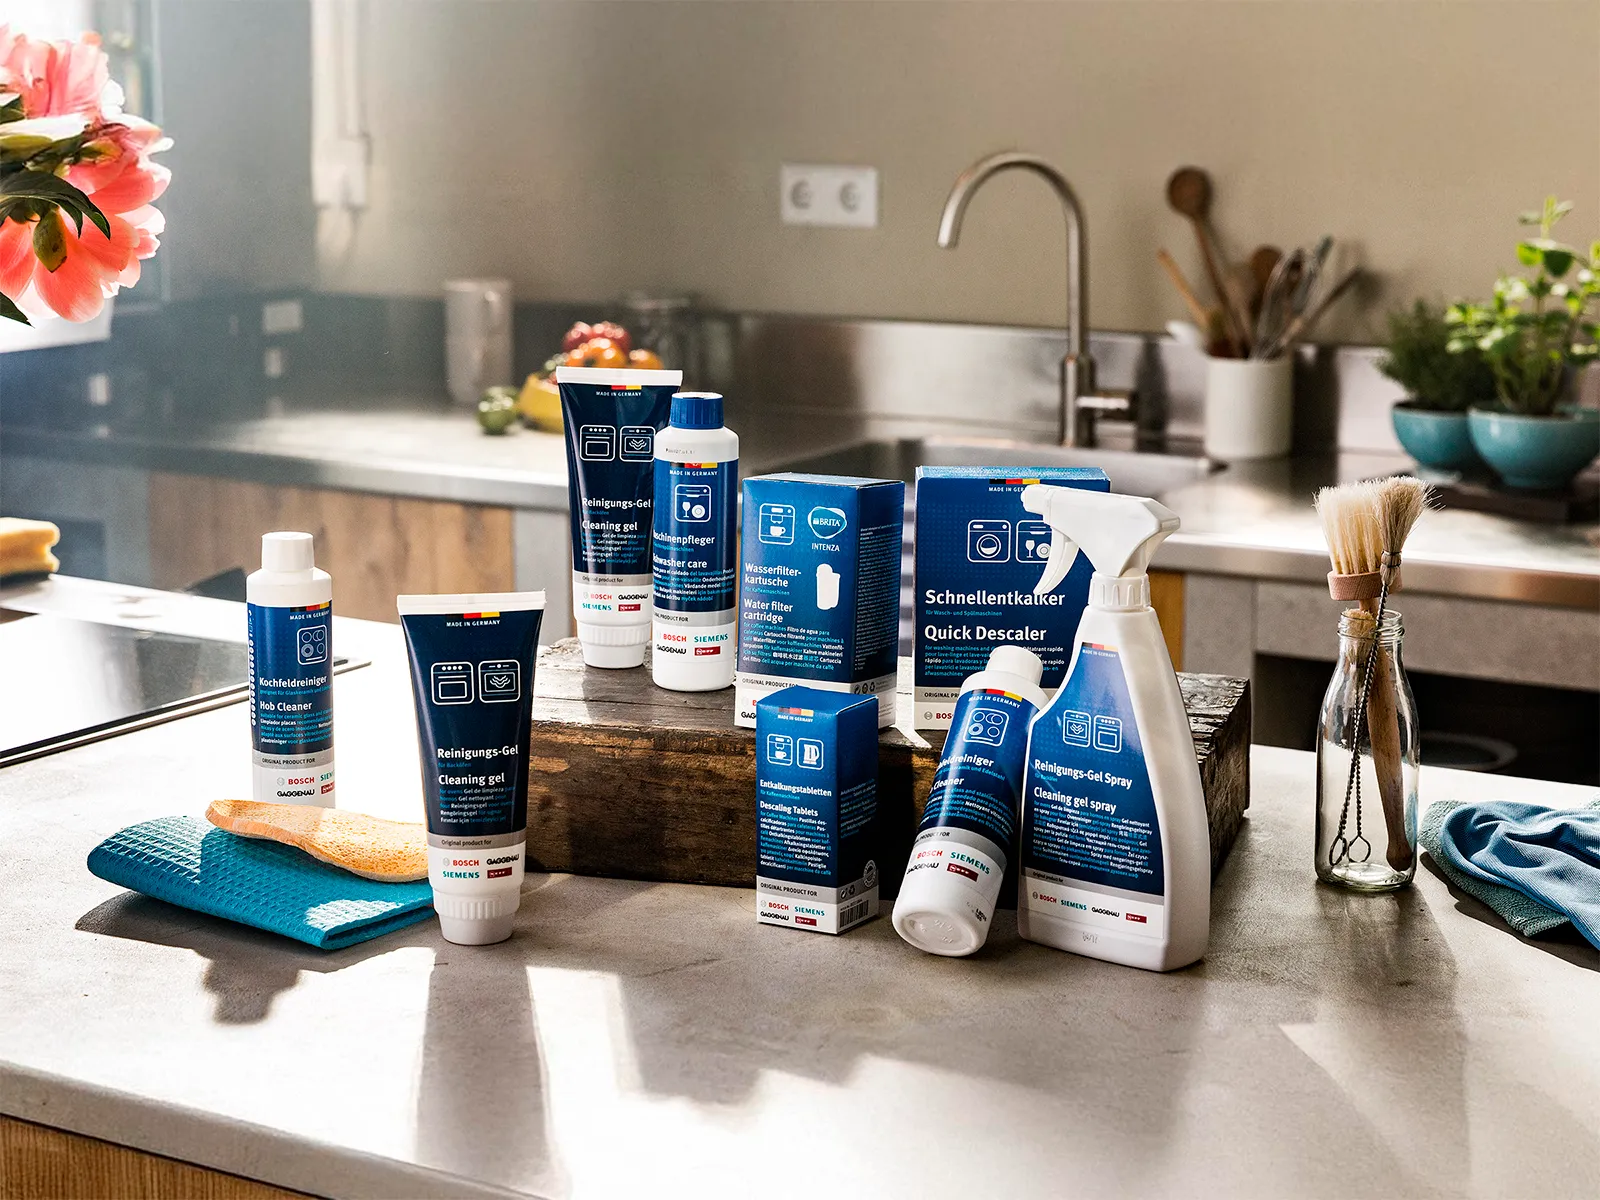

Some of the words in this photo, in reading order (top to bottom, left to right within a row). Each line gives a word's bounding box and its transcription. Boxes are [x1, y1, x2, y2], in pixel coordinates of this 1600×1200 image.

[582, 498, 651, 509] Reinigungs-Gel
[582, 521, 621, 532] Cleaning
[623, 522, 638, 532] gel
[820, 518, 840, 527] BRITA
[812, 543, 840, 552] INTENZA
[745, 563, 802, 576] Wasserfilter-
[745, 574, 789, 587] kartusche
[925, 590, 1066, 606] Schnellentkalker
[582, 603, 612, 611] SIEMENS
[744, 599, 770, 610] Water
[771, 601, 794, 612] filter
[744, 612, 784, 624] cartridge
[663, 634, 687, 642] BOSCH
[694, 634, 729, 643] SIEMENS
[925, 625, 972, 642] Quick
[976, 626, 1047, 641] Descaler
[656, 644, 687, 655] GAGGENAU
[260, 676, 327, 688] Kochfeldreiniger
[742, 678, 765, 686] ORIGINAL
[260, 701, 276, 711] Hob
[277, 703, 313, 712] Cleaner
[992, 697, 1021, 709] GERMANY
[437, 745, 519, 760] Reinigungs-Gel
[438, 774, 486, 787] Cleaning
[488, 772, 506, 786] gel
[982, 768, 1006, 781] Edelstahl
[1035, 759, 1104, 783] Reinigungs-Gel
[1104, 773, 1133, 791] Spray
[288, 777, 315, 785] BOSCH
[934, 778, 965, 790] Cleaner
[277, 789, 316, 798] GAGGENAU
[760, 779, 832, 796] Entkalkungstabletten
[469, 795, 495, 803] nettoyant
[1034, 787, 1073, 806] Cleaning
[1074, 797, 1089, 808] gel
[1090, 800, 1117, 815] spray
[441, 810, 478, 818] Rengöringsgel
[760, 800, 792, 814] Descaling
[793, 806, 819, 817] Tablets
[487, 854, 520, 865] GAGGENAU
[950, 852, 991, 875] SIEMENS
[443, 871, 480, 879] SIEMENS
[760, 883, 783, 892] ORIGINAL
[783, 887, 807, 895] PRODUCT
[768, 902, 790, 911] BOSCH
[794, 906, 826, 917] SIEMENS
[1040, 894, 1058, 904] BOSCH
[1061, 900, 1088, 911] SIEMENS
[1091, 907, 1121, 918] GAGGENAU
[760, 911, 790, 921] GAGGENAU
